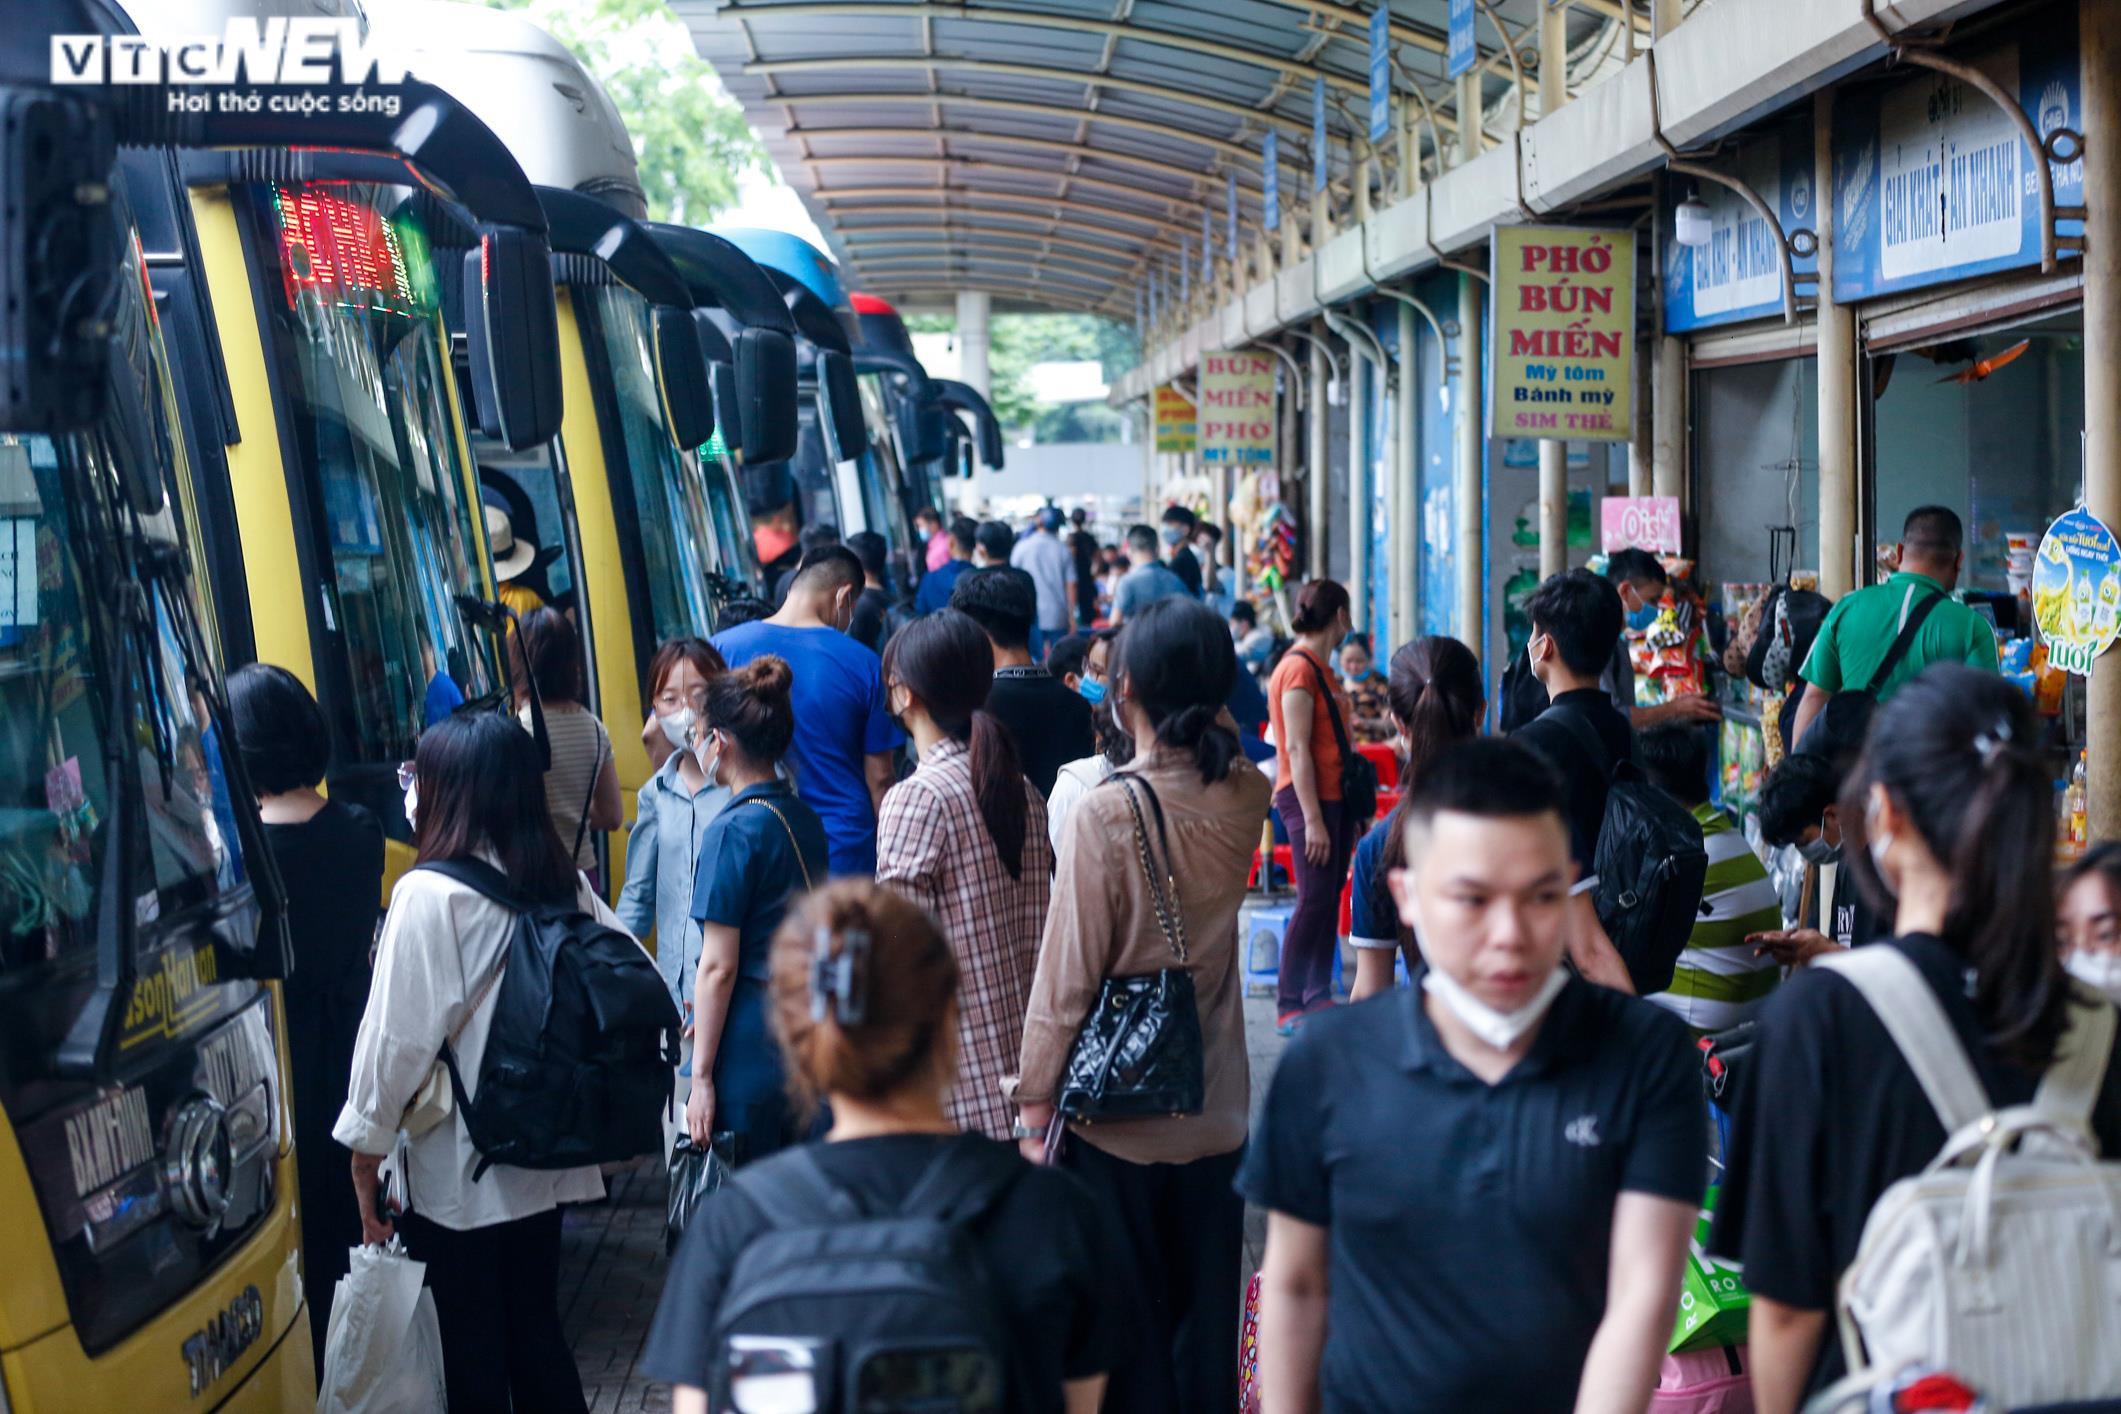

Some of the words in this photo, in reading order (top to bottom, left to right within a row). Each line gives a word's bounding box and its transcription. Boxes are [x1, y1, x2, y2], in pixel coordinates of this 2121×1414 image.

[1885, 143, 1907, 248] GIẢI
[1910, 149, 1940, 241] KHÁT
[1950, 142, 1967, 231] ĂN
[1970, 140, 2016, 228] NHANH
[1519, 233, 1613, 274] PHỞ
[1518, 276, 1614, 315] BÚN
[1509, 317, 1623, 359] MIẾN
[1564, 364, 1605, 382] tôm
[1514, 385, 1573, 403] Bánh
[1514, 411, 1558, 429] SIM
